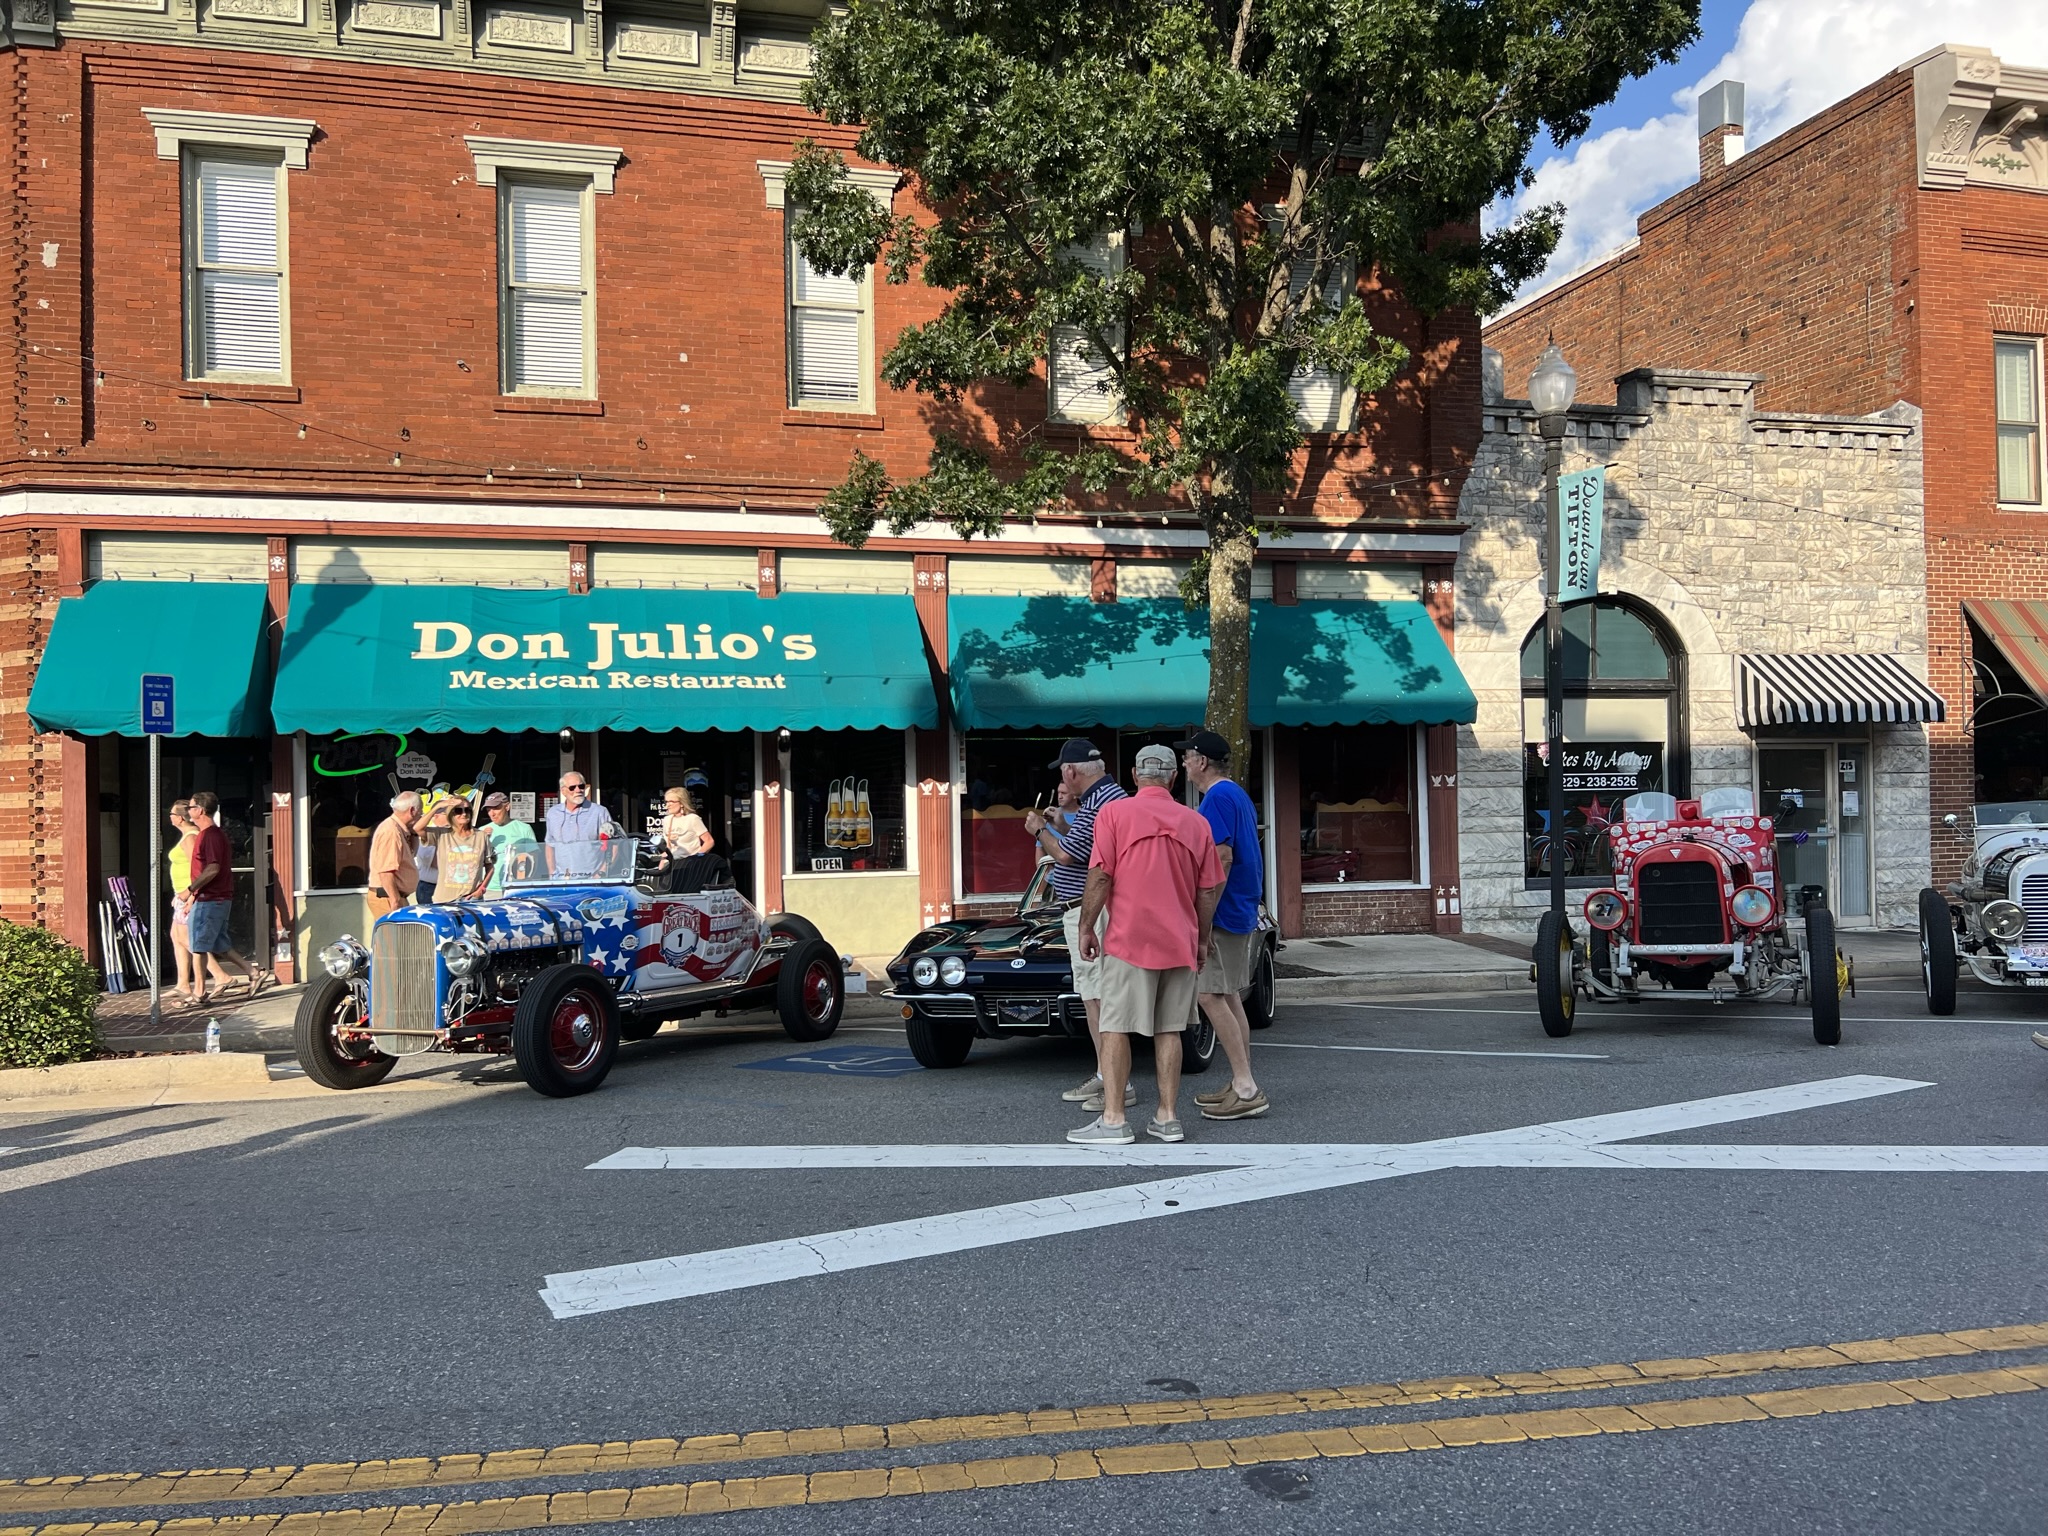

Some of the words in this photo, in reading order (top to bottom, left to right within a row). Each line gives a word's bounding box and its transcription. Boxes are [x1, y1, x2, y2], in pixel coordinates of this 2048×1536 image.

[1568, 485, 1579, 587] TIFTON
[1580, 476, 1598, 592] Downtown
[411, 621, 570, 660] Don
[587, 623, 817, 670] Julio's
[449, 670, 600, 690] Mexican
[608, 671, 787, 690] Restaurant
[1543, 751, 1579, 767] Ckes
[1583, 750, 1603, 770] By
[815, 859, 841, 869] OPEN
[1595, 903, 1614, 917] 27
[662, 914, 685, 937] GREAT
[677, 933, 683, 948] 1
[918, 966, 932, 977] 135
